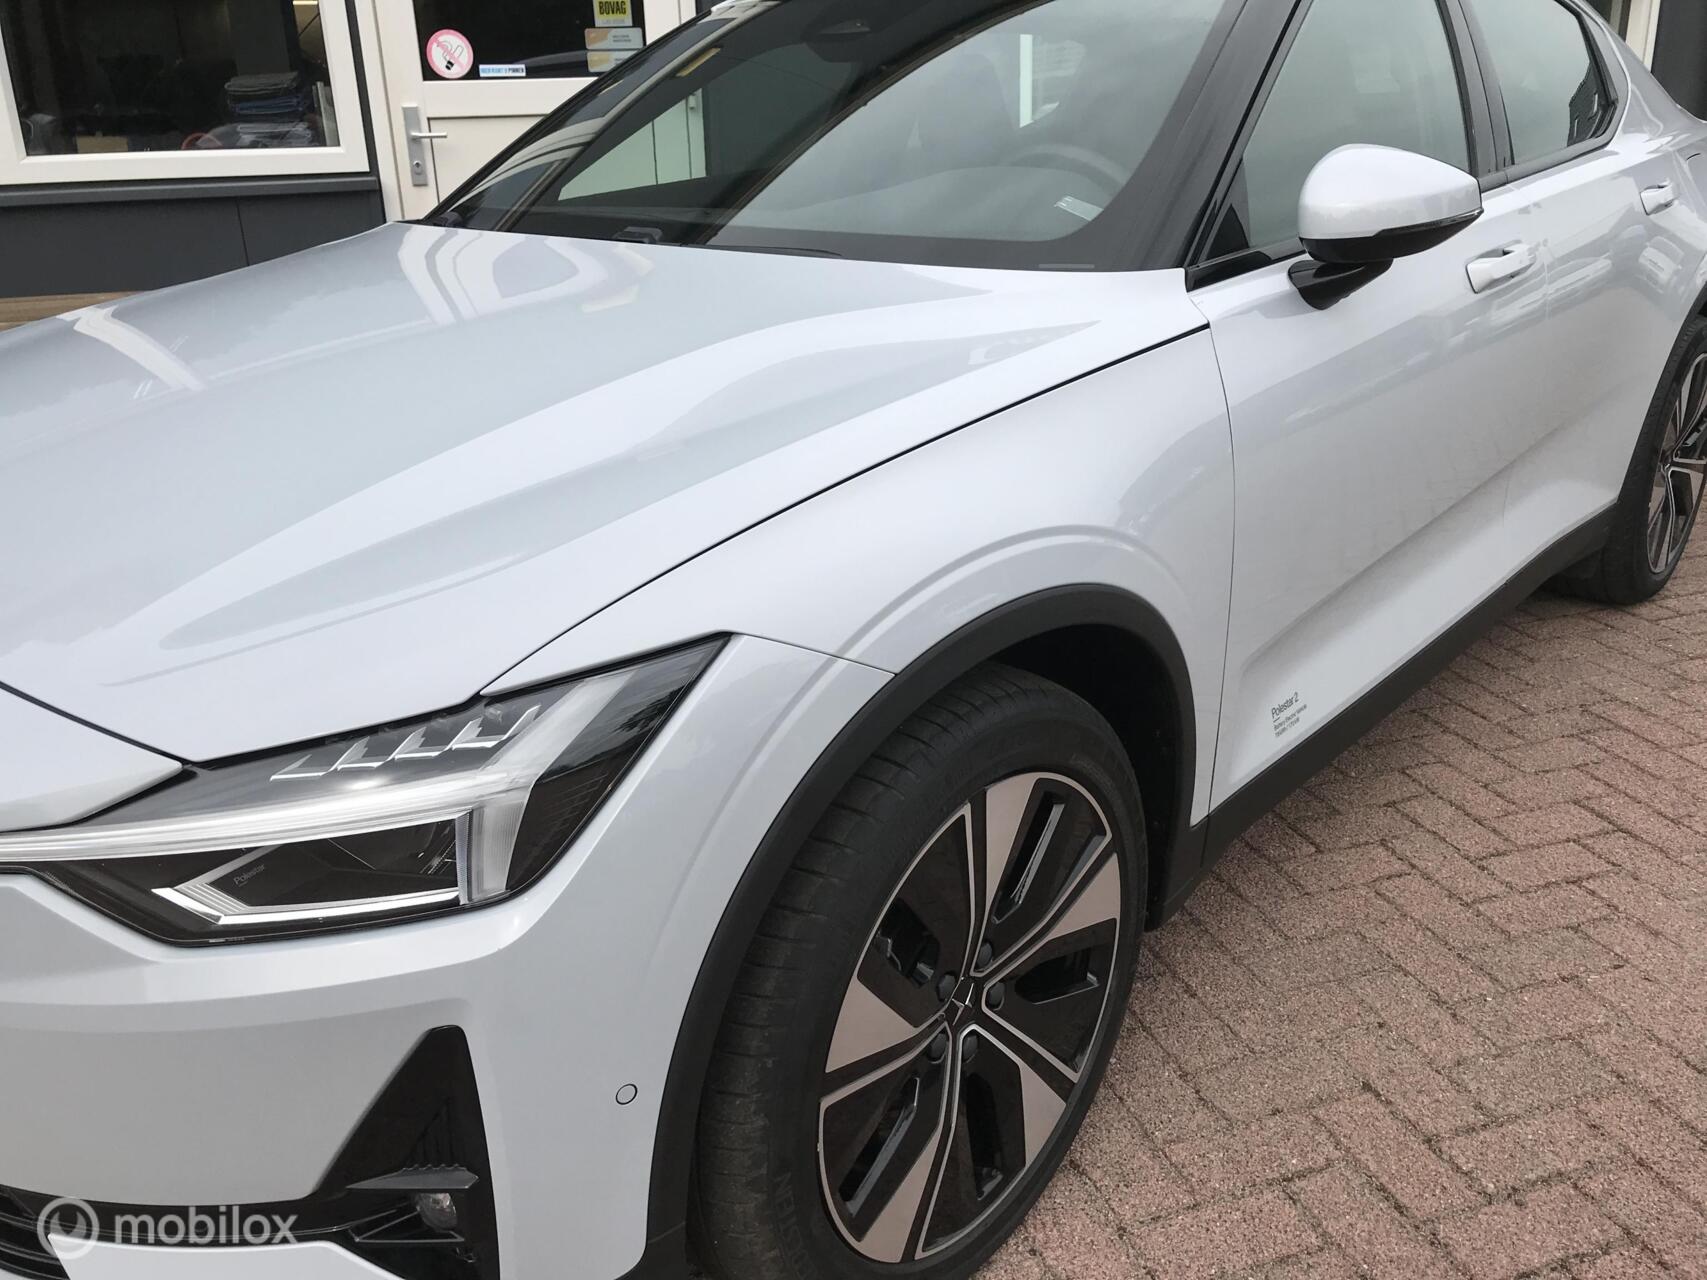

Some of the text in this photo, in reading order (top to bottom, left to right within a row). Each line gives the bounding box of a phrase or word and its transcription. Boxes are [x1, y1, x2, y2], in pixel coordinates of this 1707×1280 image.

[598, 1, 627, 15] BOVAG
[1271, 691, 1300, 719] Polestar 2
